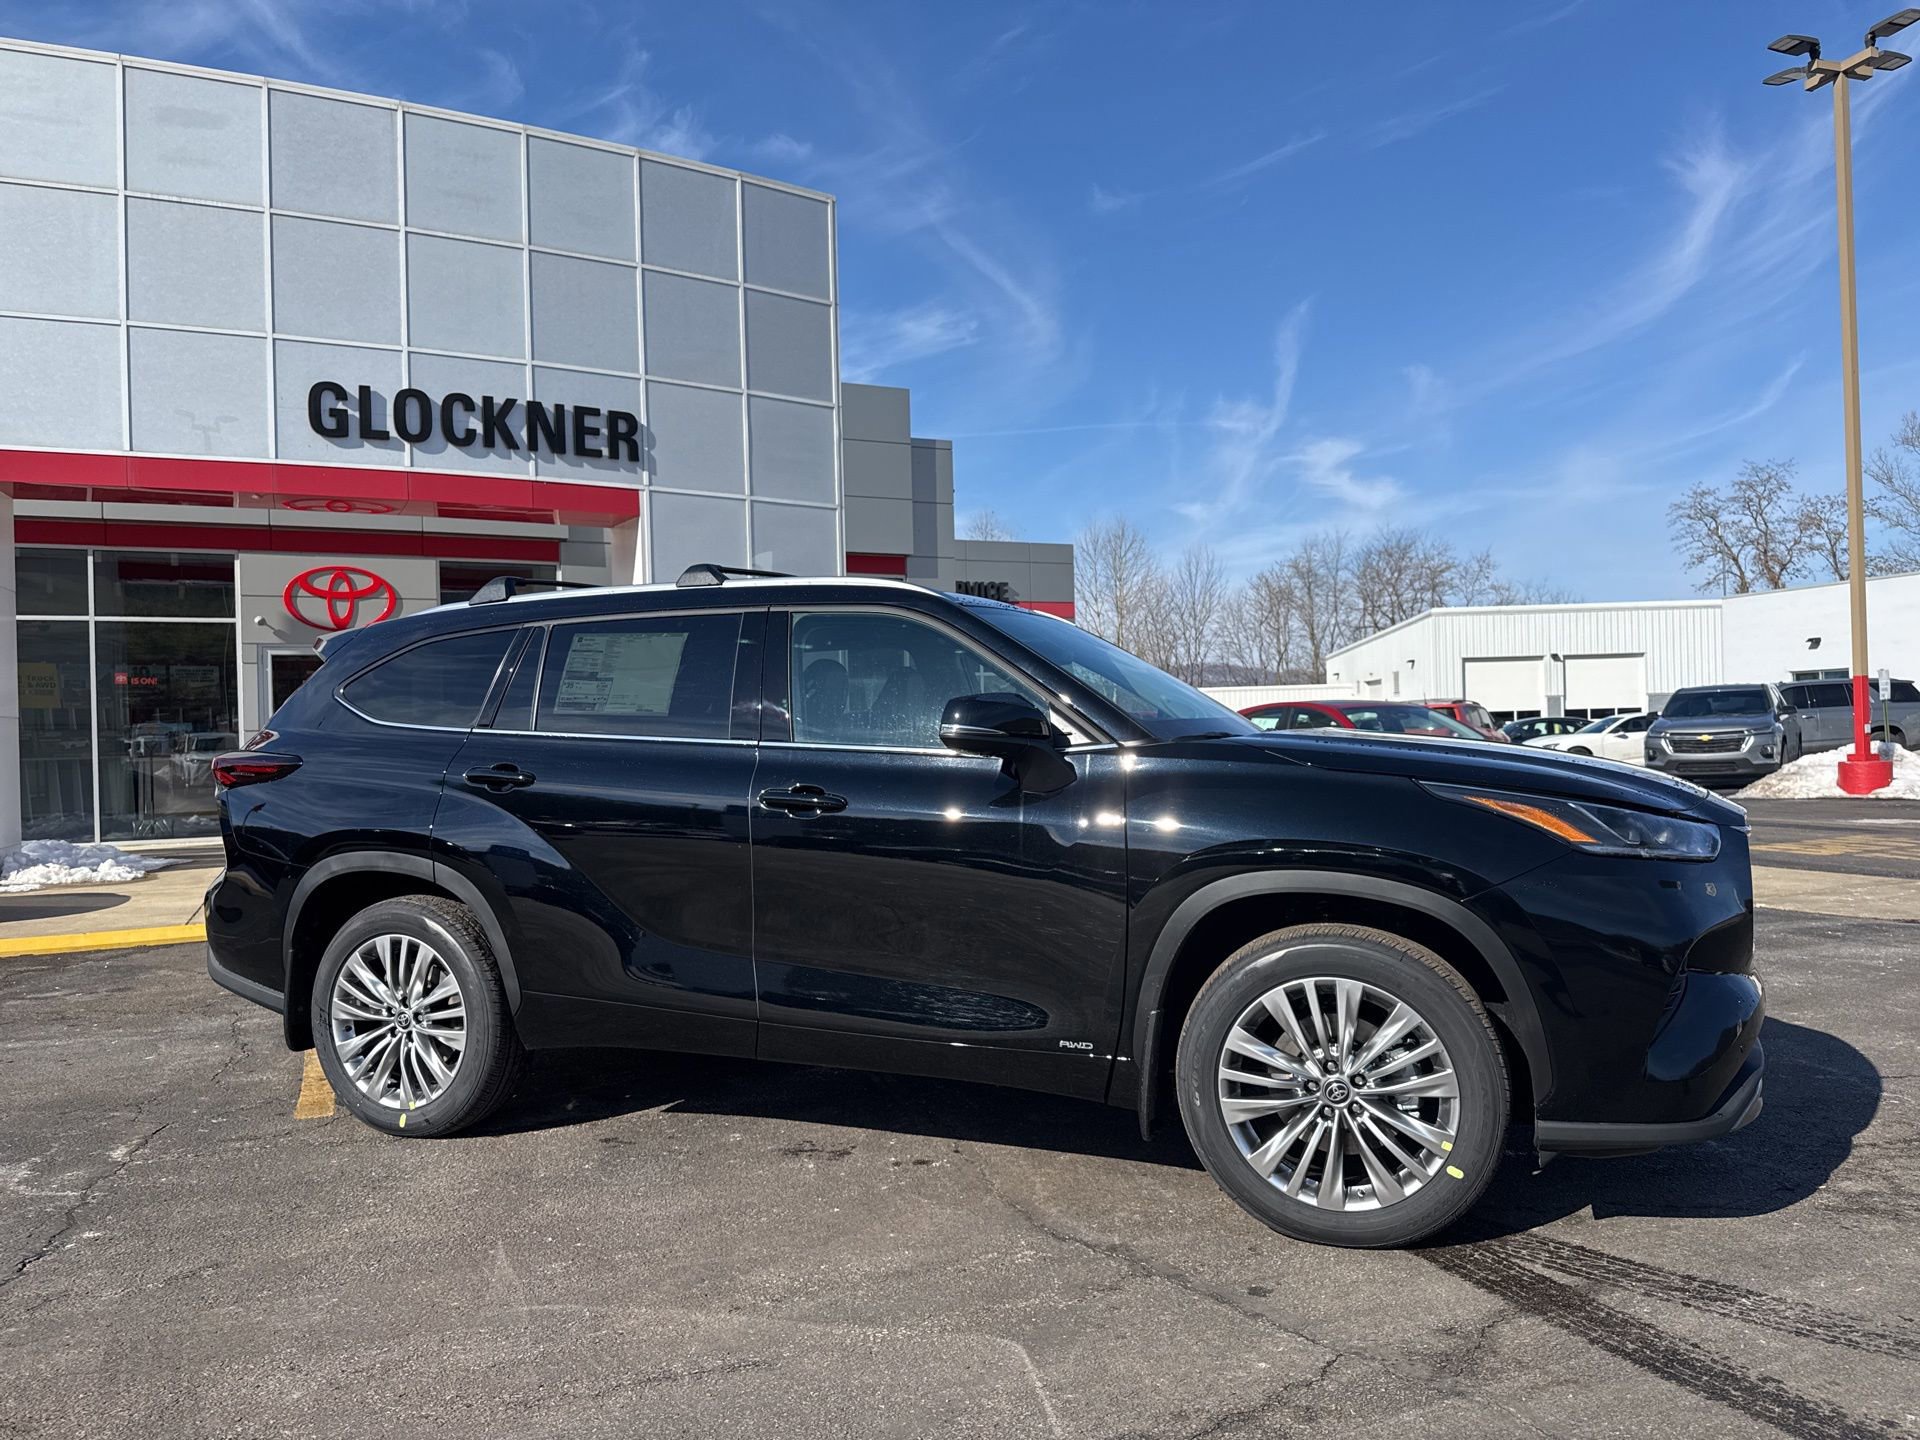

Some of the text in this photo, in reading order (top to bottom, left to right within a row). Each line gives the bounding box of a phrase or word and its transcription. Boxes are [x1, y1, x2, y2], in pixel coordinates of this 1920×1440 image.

[307, 380, 640, 462] GLOCKNER
[130, 677, 158, 686] IS ON!
[1059, 1040, 1094, 1050] AWD
